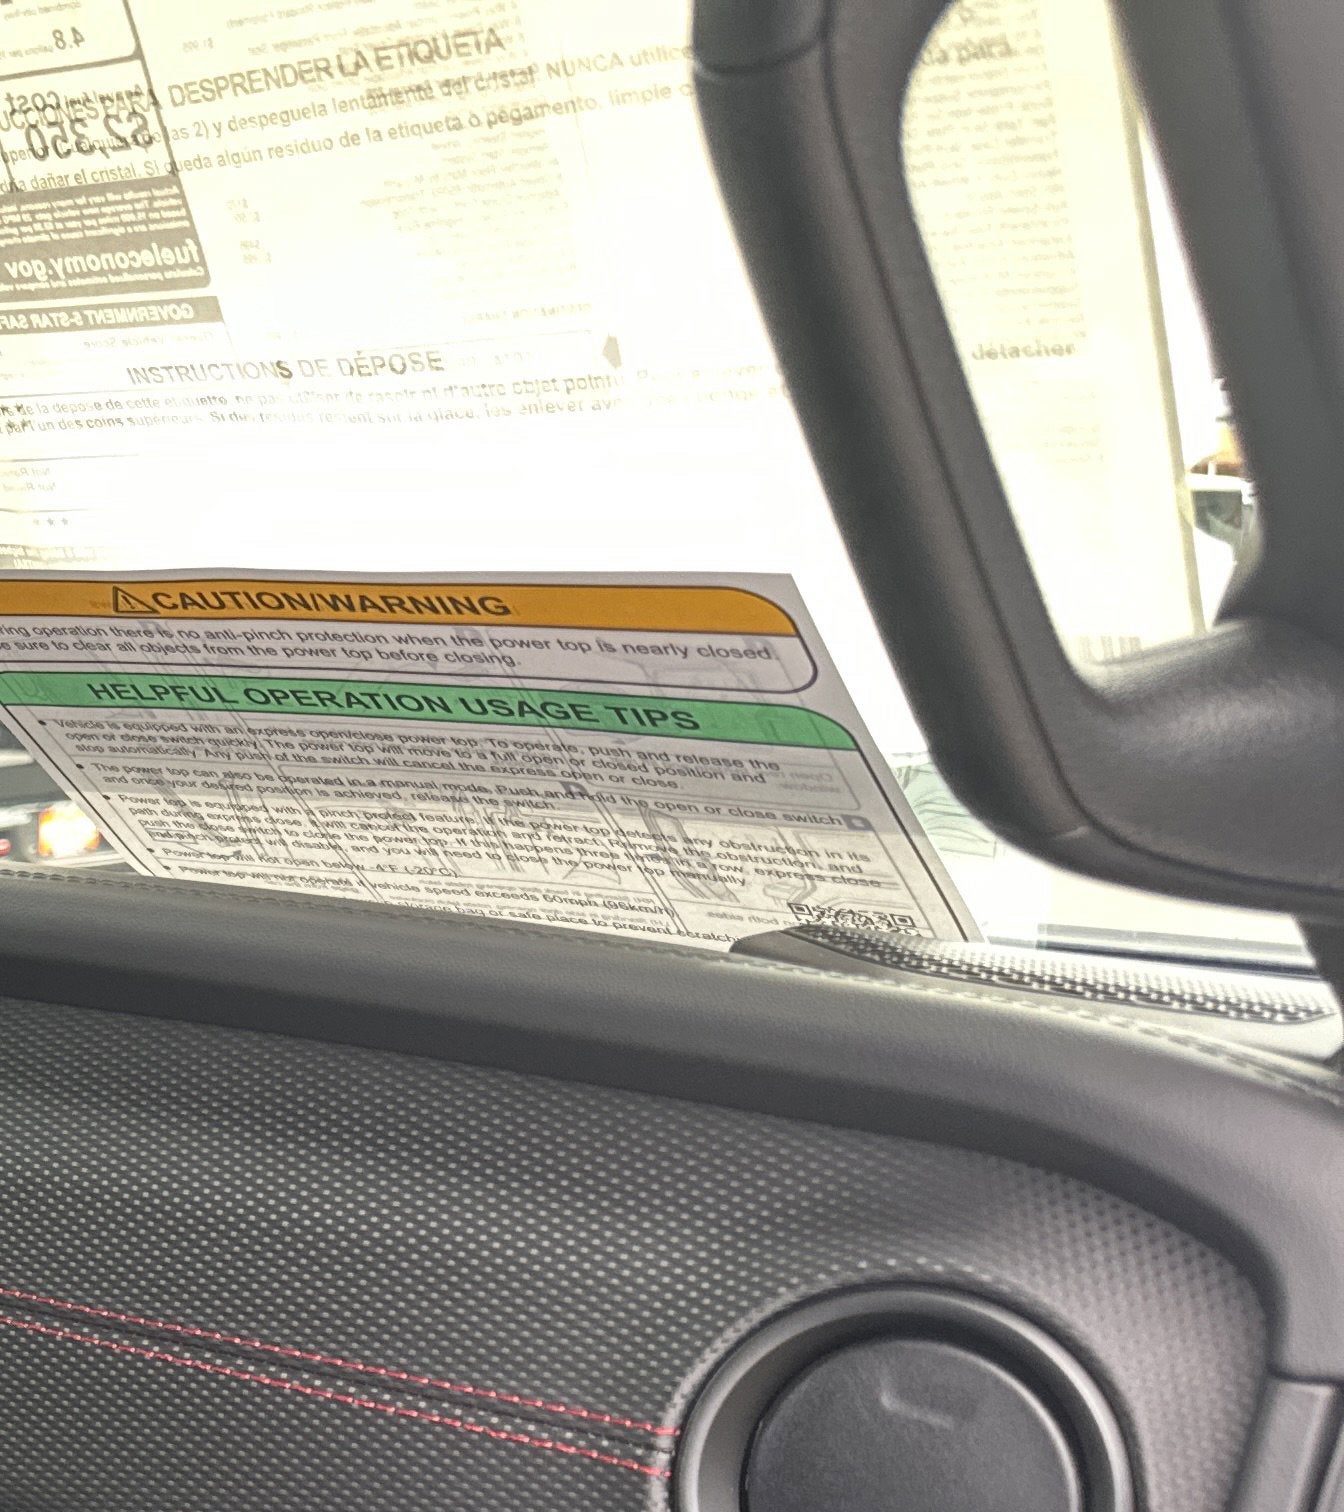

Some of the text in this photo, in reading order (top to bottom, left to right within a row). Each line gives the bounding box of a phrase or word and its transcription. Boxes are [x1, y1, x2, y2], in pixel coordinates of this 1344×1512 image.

[169, 58, 334, 109] DESPRENDER
[337, 50, 370, 78] LA
[373, 27, 506, 73] ETIQUETA
[546, 53, 624, 80] NUNCA
[31, 172, 70, 192] dañar
[74, 168, 86, 186] el
[268, 138, 333, 160] residuo
[339, 133, 361, 149] de
[366, 127, 383, 142] la
[388, 113, 464, 141] etiqueta
[127, 350, 445, 386] INSTRUCTIONS DE DÉPOSE
[150, 591, 511, 616] CAUTION/WARNING
[14, 642, 49, 650] sure
[51, 640, 69, 650] to
[71, 640, 113, 651] clear
[115, 641, 136, 652] all
[138, 641, 202, 657] objects
[203, 643, 243, 654] from
[247, 644, 277, 655] the
[282, 647, 338, 660] power
[342, 647, 374, 662] top
[376, 648, 438, 662] before
[443, 650, 521, 668] closing.
[30, 625, 109, 640] operation
[110, 626, 153, 637] there
[156, 627, 173, 638] is
[177, 629, 200, 638] no
[202, 627, 293, 644] anti-pinch
[295, 629, 390, 647] protection
[392, 632, 446, 646] when
[450, 634, 484, 647] the
[491, 638, 554, 653] power
[557, 638, 593, 655] top
[597, 640, 615, 653] is
[620, 641, 690, 660] nearly
[695, 644, 777, 660] closed.
[87, 682, 700, 730] HELPFUL OPERATION USAGE TIPS
